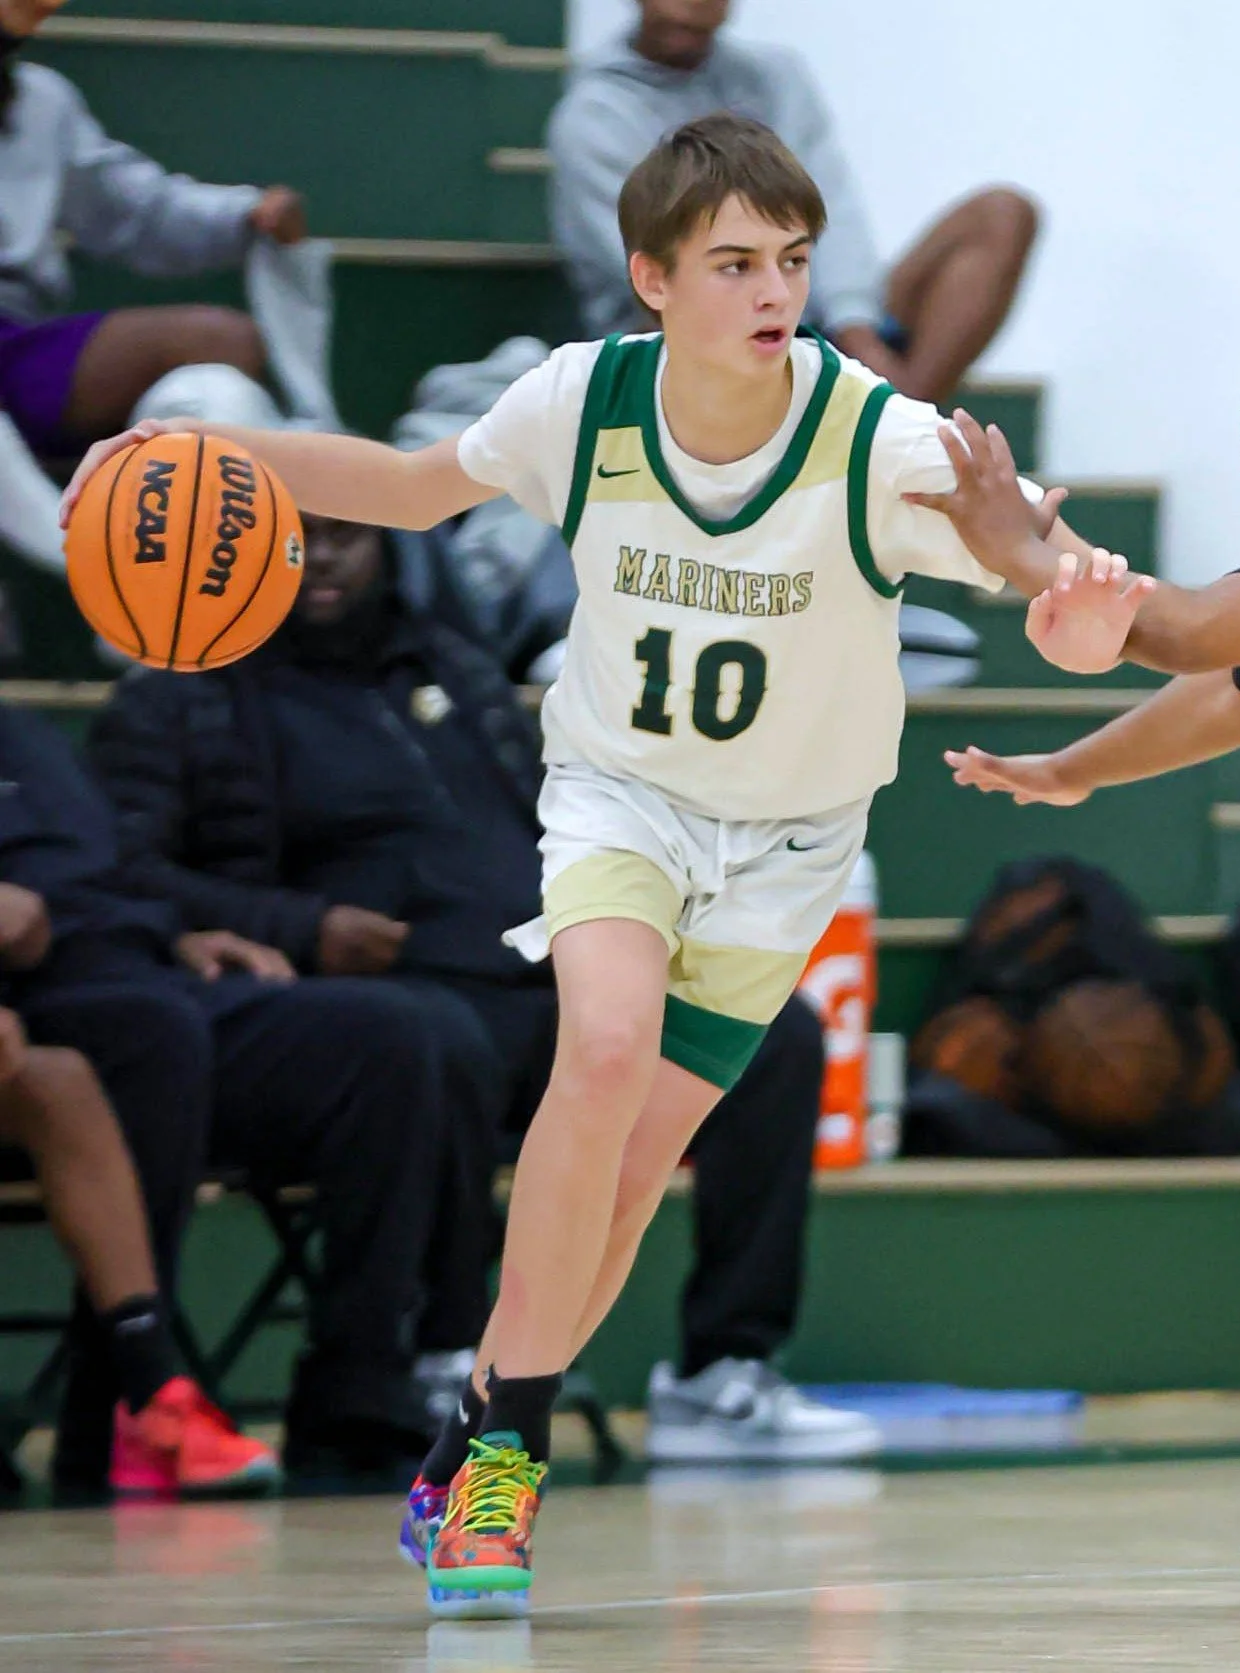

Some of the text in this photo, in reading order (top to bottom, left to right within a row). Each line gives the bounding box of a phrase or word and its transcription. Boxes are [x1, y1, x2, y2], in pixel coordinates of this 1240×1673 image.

[135, 459, 177, 564] NCAA
[198, 455, 256, 597] Wilson
[613, 546, 813, 616] MARINERS
[631, 625, 767, 742] 10
